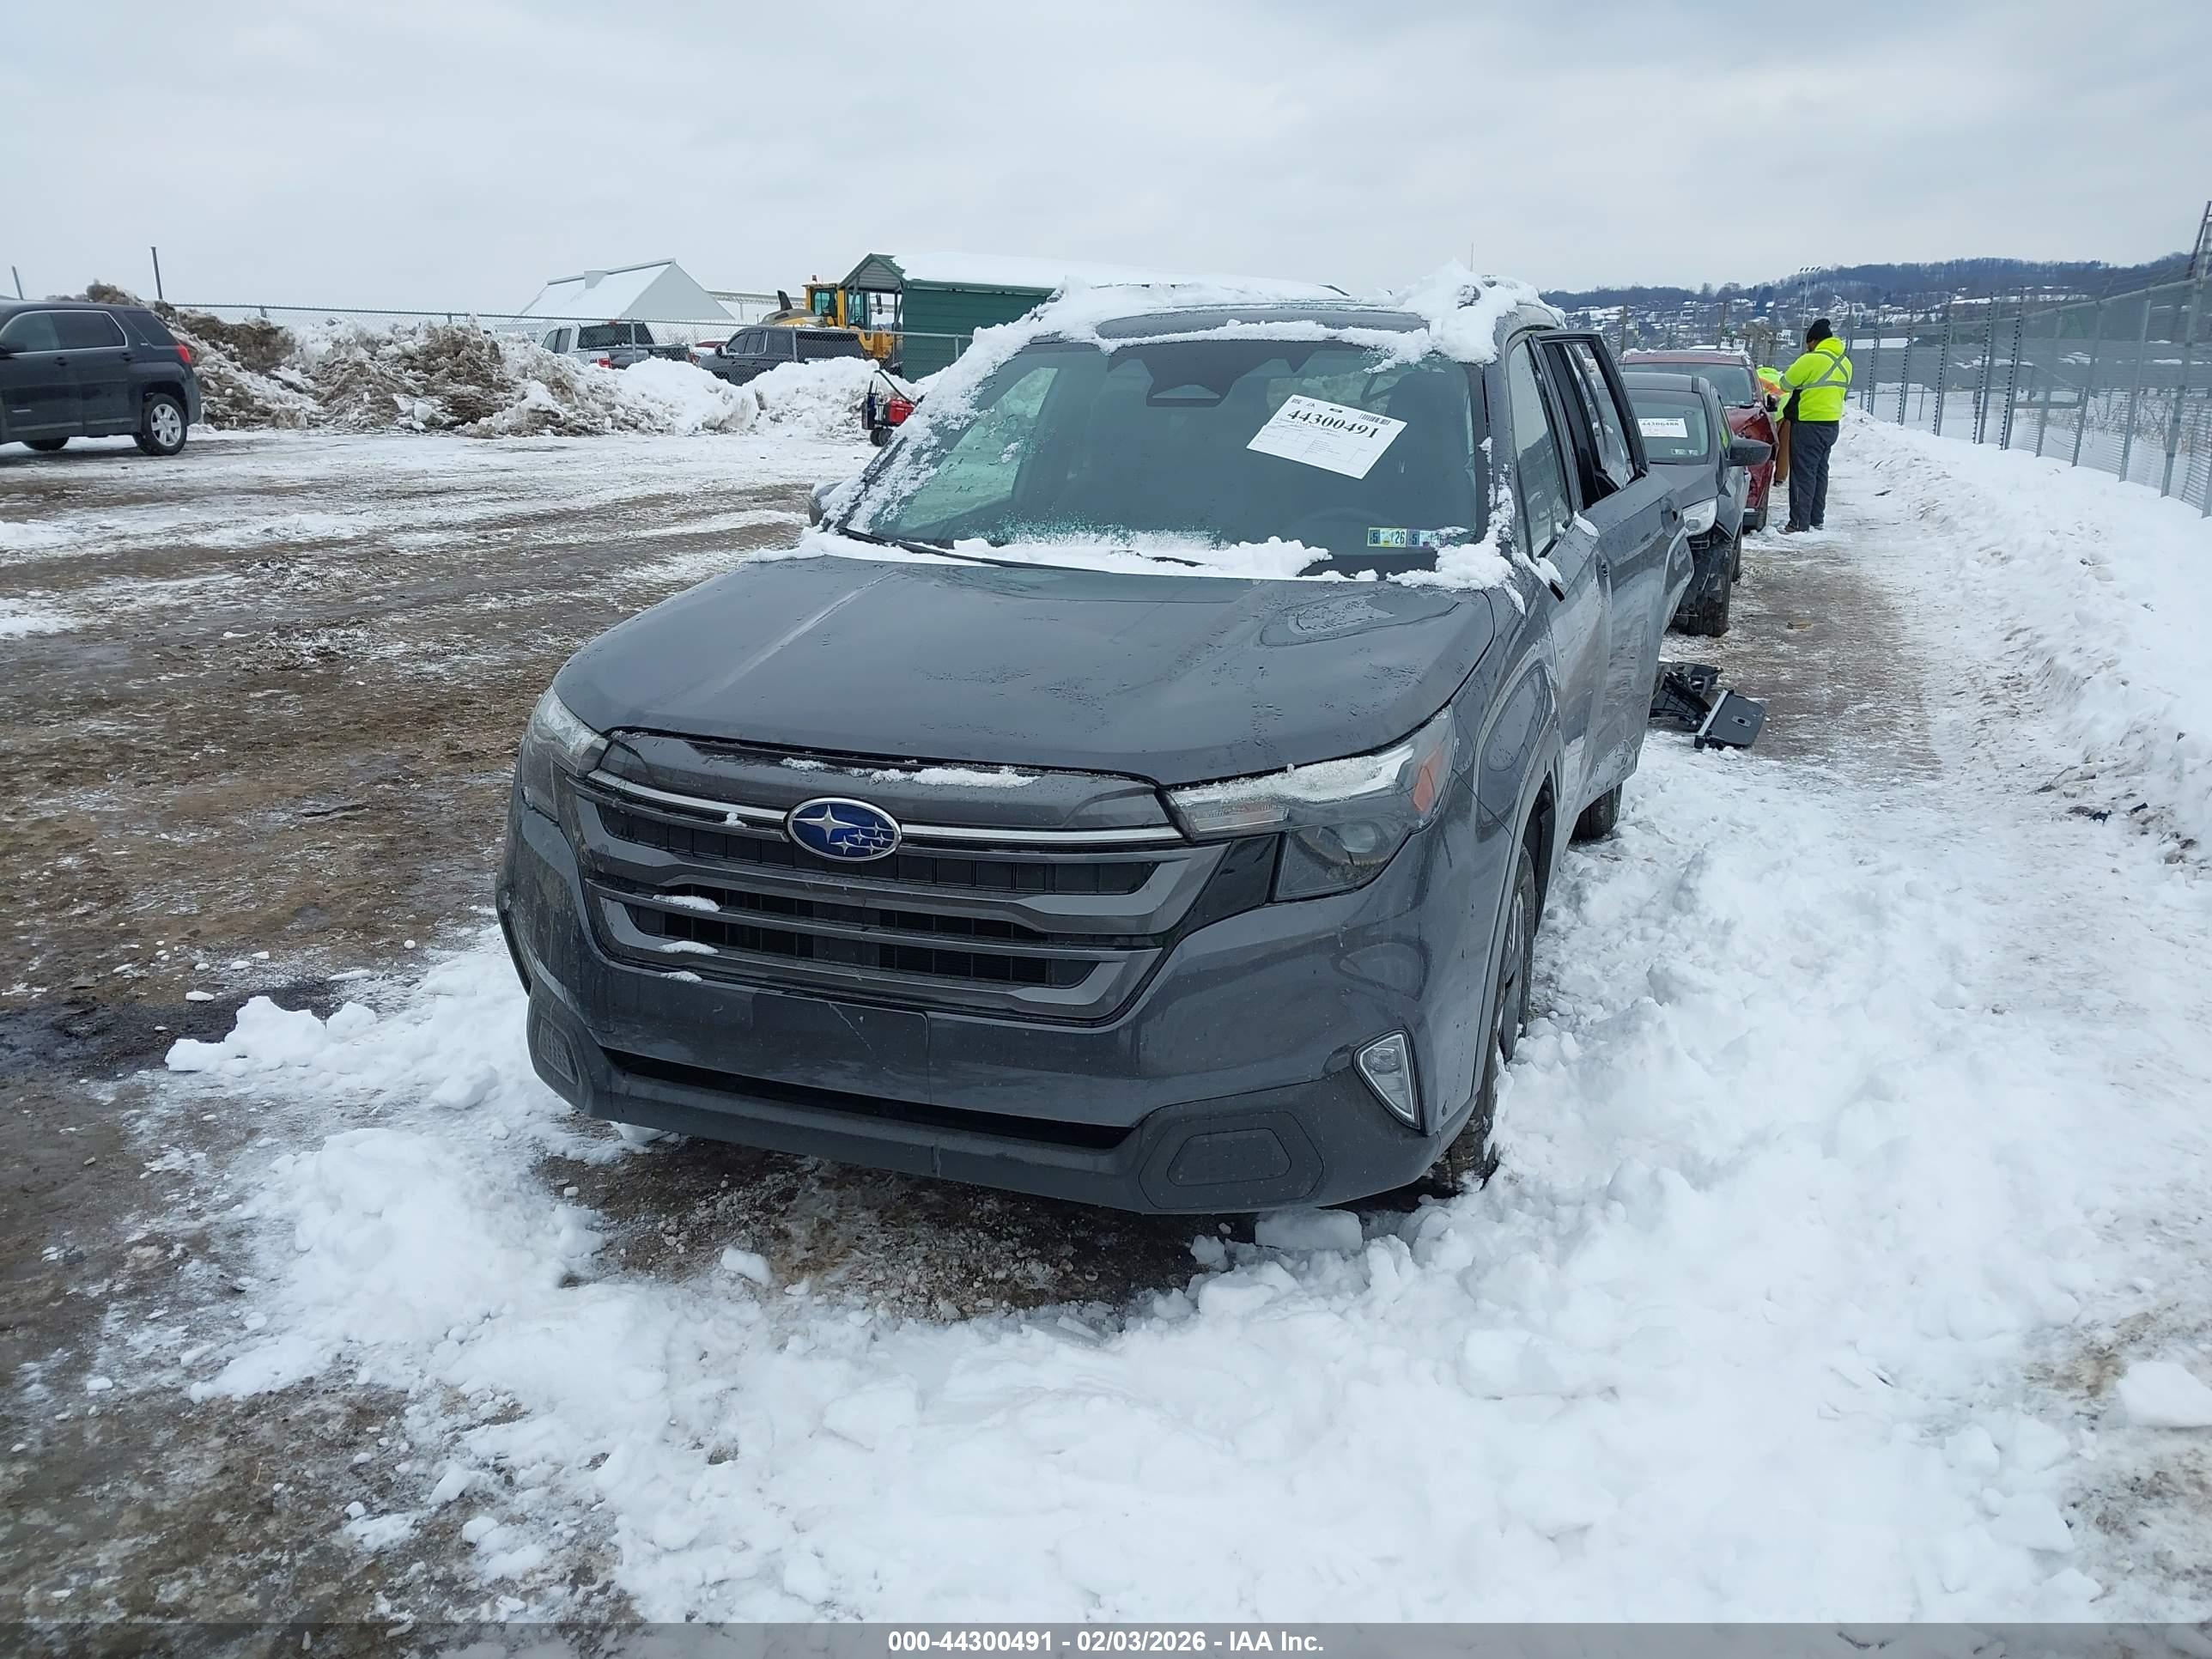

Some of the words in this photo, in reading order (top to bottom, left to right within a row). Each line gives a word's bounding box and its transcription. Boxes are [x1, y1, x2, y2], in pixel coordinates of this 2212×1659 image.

[1287, 410, 1380, 439] 44300491
[1372, 532, 1378, 544] 5
[1395, 532, 1405, 544] 26
[1412, 533, 1418, 545] 5
